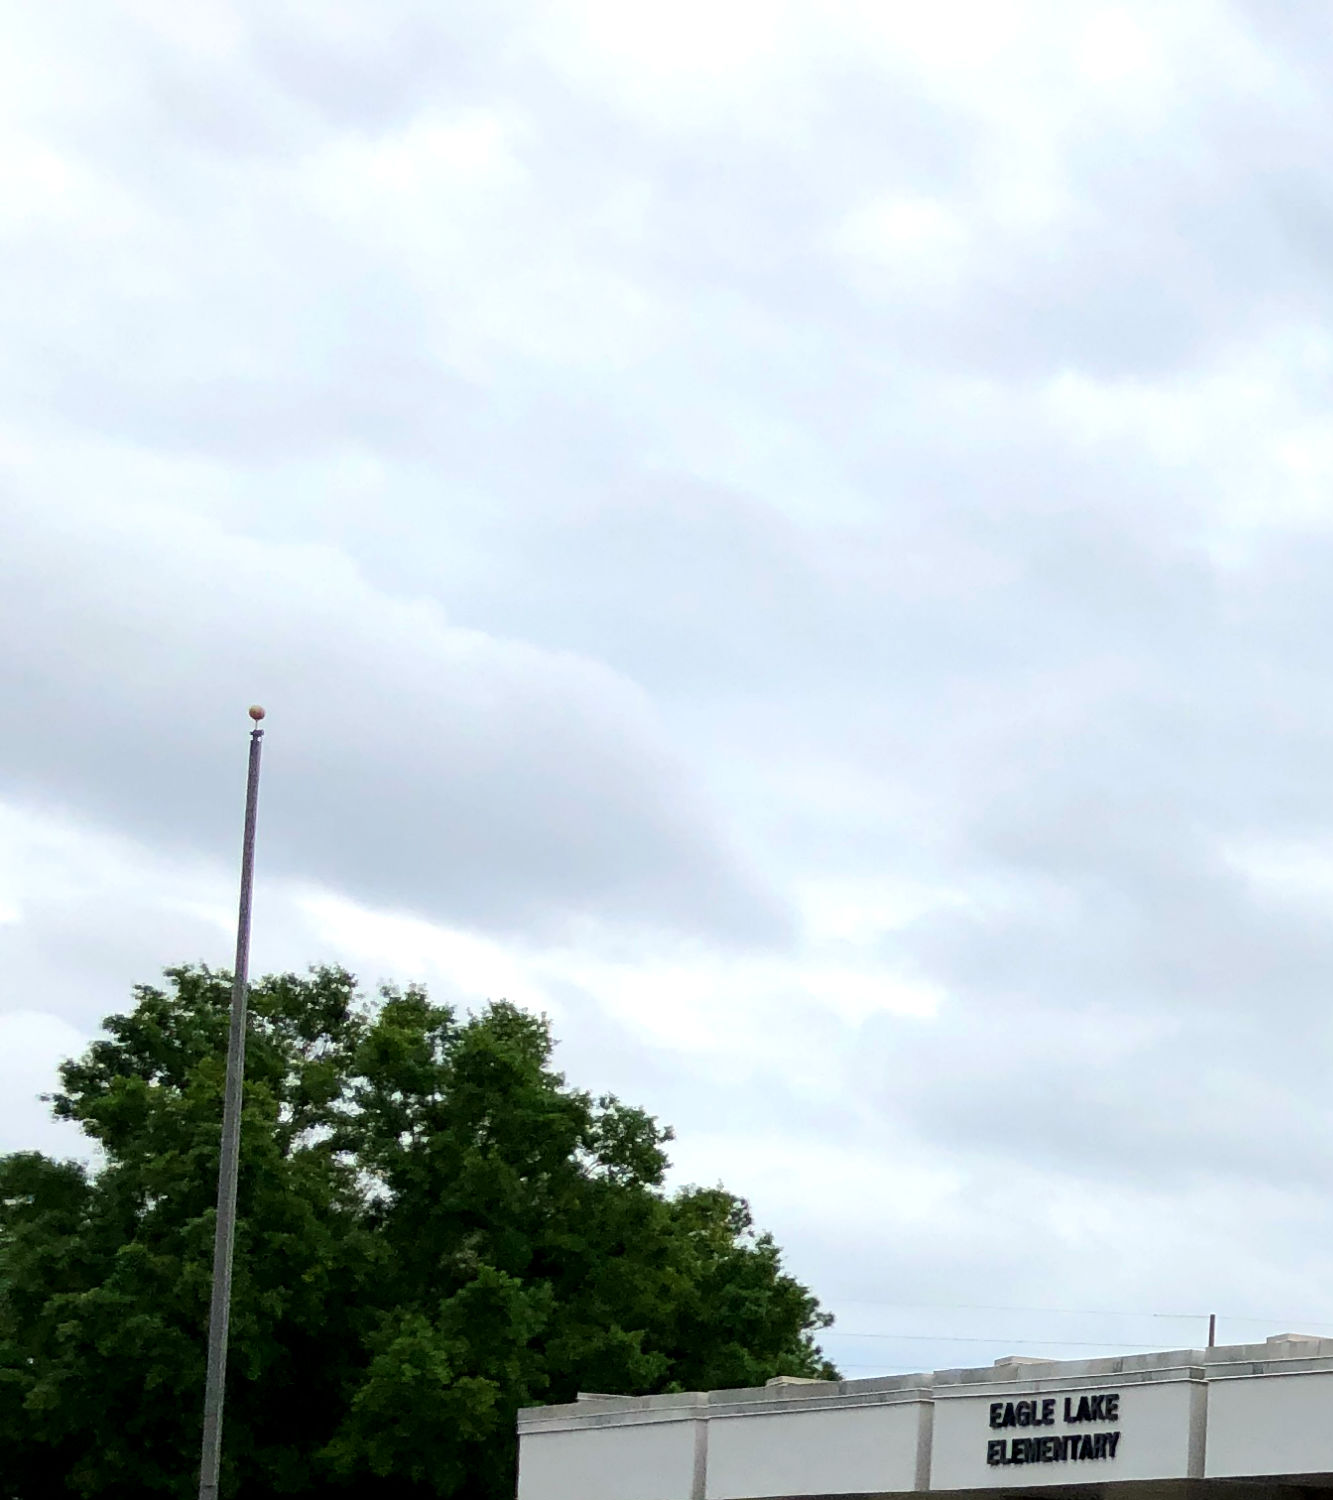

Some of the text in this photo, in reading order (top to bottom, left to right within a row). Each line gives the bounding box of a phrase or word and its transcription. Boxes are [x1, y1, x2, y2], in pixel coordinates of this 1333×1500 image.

[989, 1394, 1120, 1429] EAGLE LAKE
[987, 1431, 1121, 1466] ELEMENTARY
